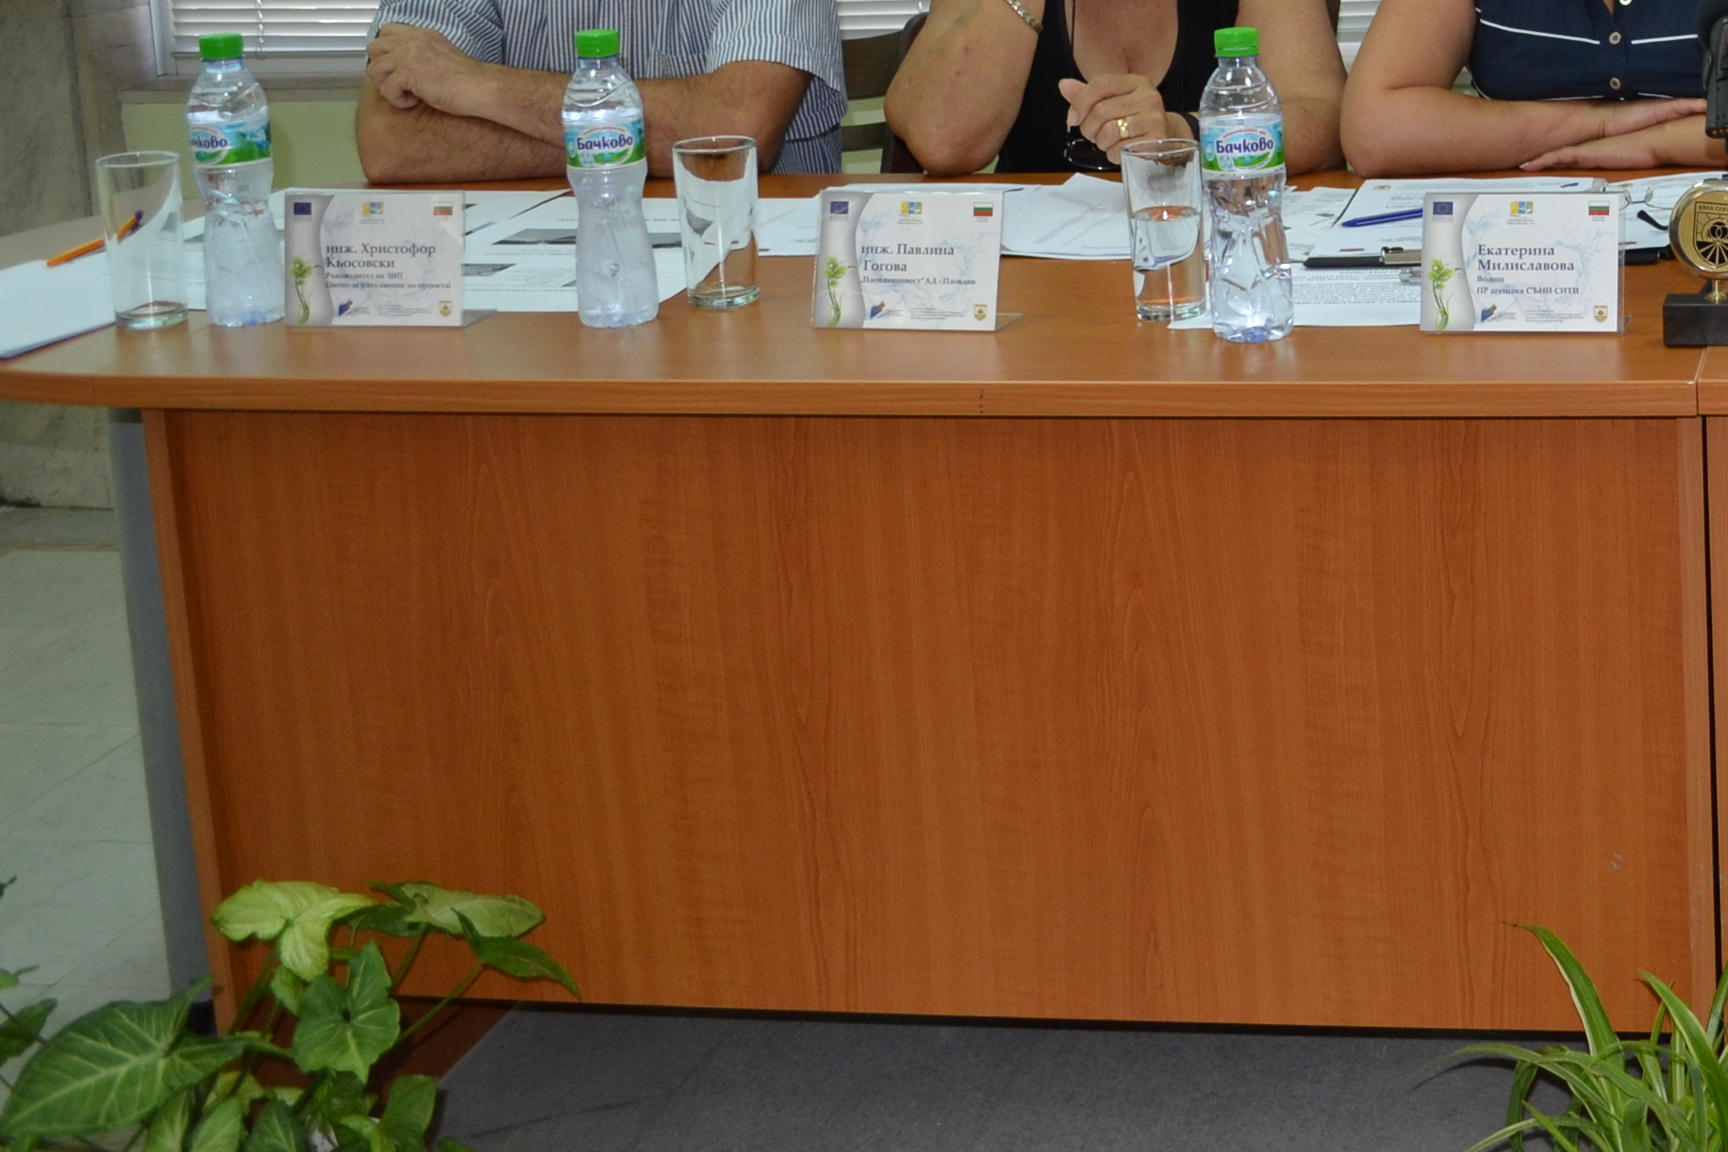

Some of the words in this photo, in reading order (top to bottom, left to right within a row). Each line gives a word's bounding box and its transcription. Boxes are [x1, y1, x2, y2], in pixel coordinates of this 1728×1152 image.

[576, 134, 633, 151] Бачково
[1215, 136, 1274, 154] Бачково
[361, 242, 437, 258] Христофор
[861, 245, 893, 256] инж.
[897, 243, 955, 256] Павлина
[1478, 244, 1555, 259] Екатерина
[326, 257, 395, 269] Кьосовски
[863, 259, 908, 272] Гогова
[1478, 259, 1575, 272] Милиславова
